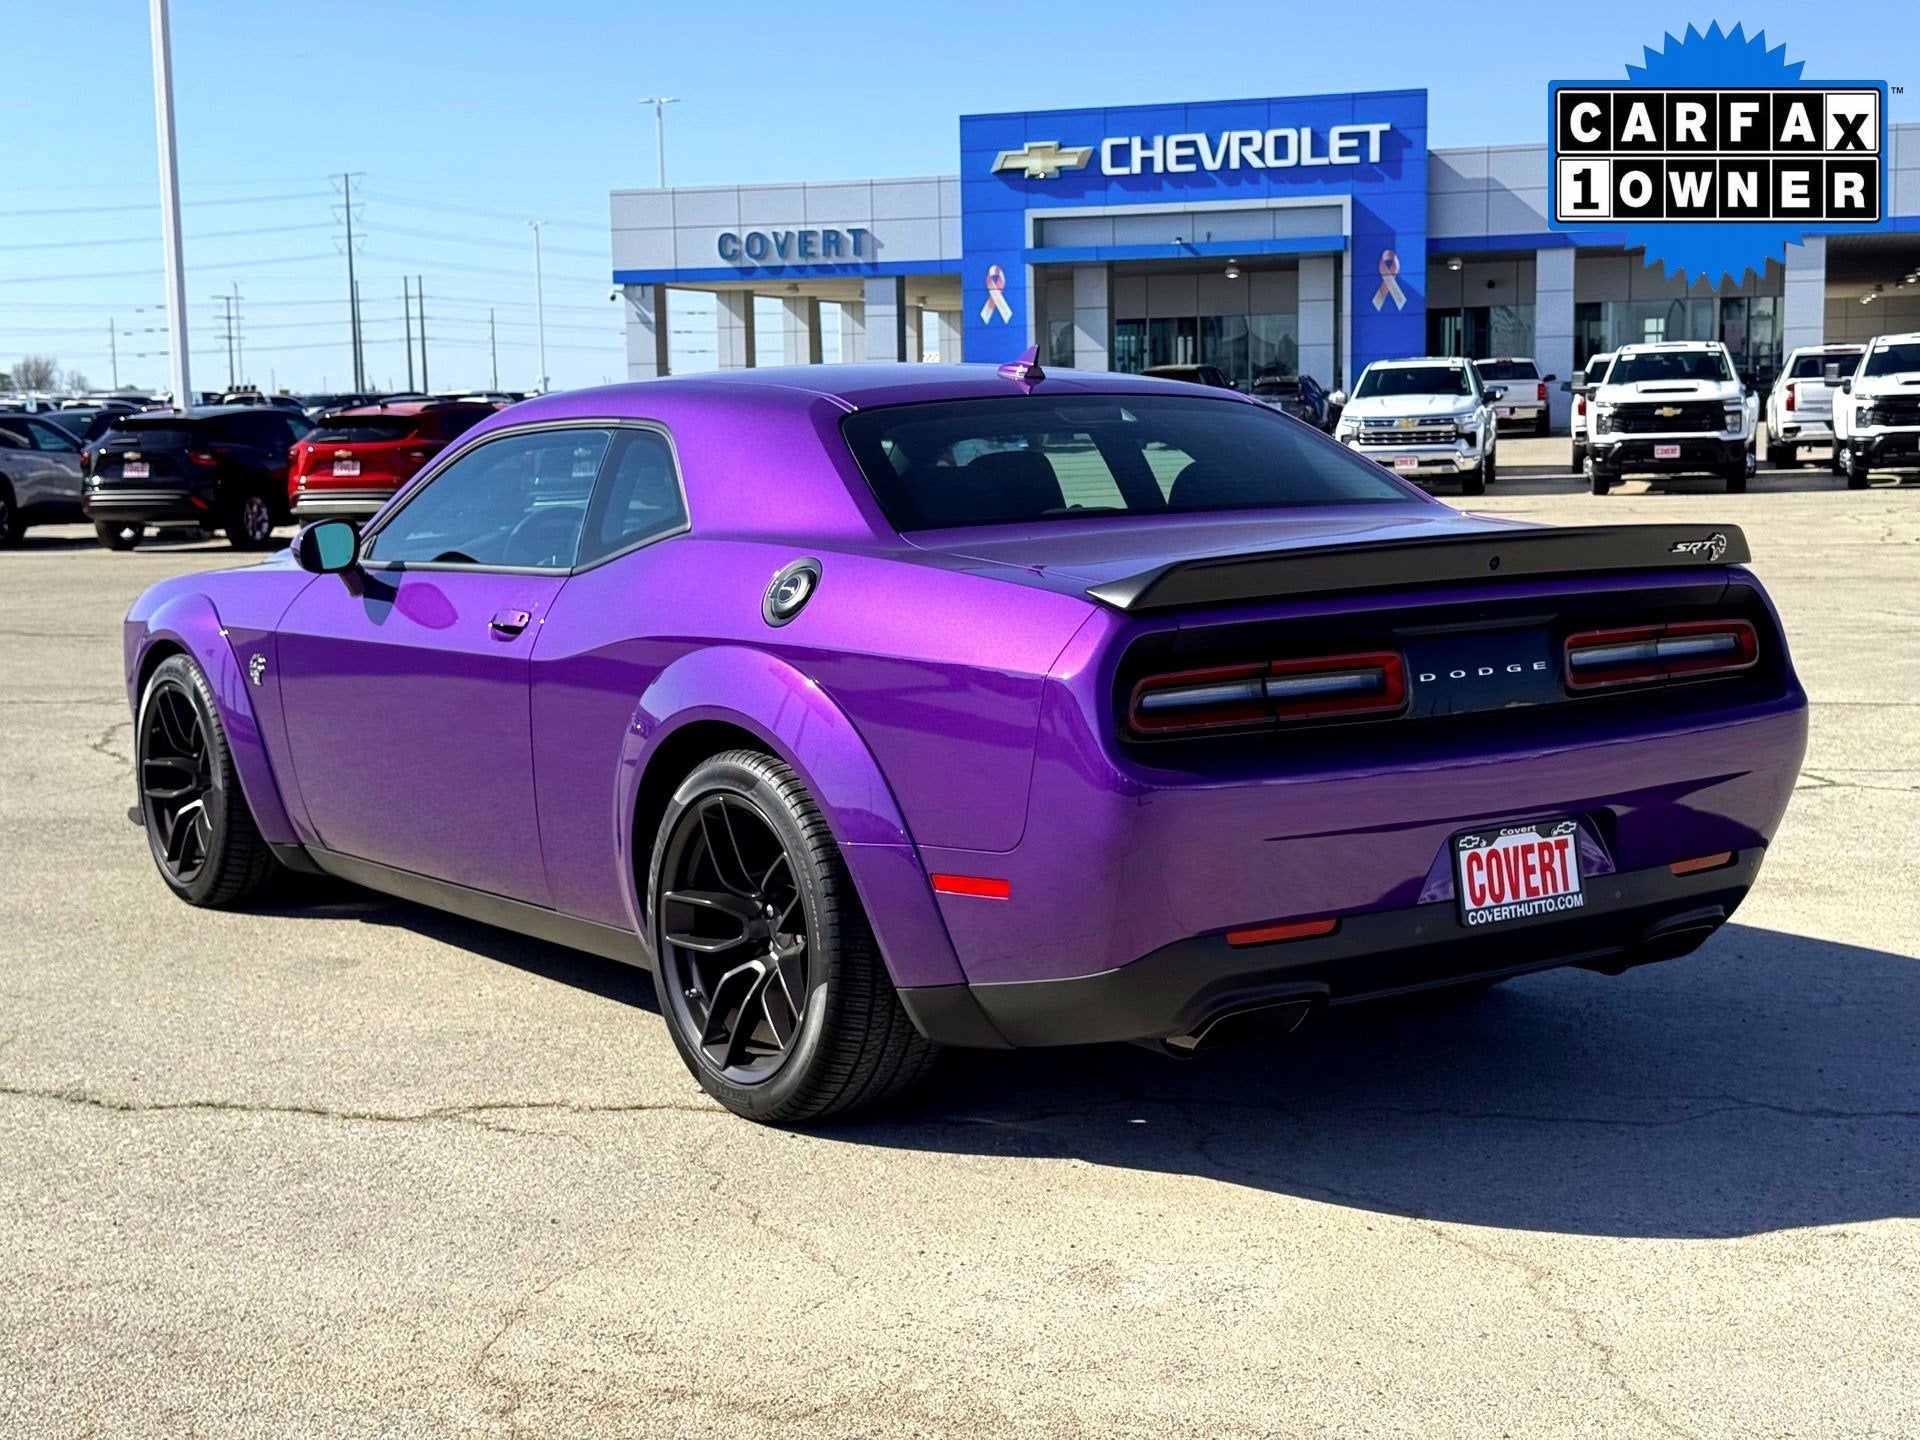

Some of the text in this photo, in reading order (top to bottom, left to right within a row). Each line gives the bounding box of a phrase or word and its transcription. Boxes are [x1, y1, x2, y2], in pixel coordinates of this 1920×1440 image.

[1101, 123, 1391, 176] CHEVROLET
[718, 228, 868, 262] COVERT
[1671, 540, 1716, 555] SRT
[1419, 661, 1547, 683] DODGE
[1499, 825, 1537, 837] Covert
[1466, 838, 1569, 907] COVERT
[1467, 893, 1584, 926] COVERTHUTTO.COM
